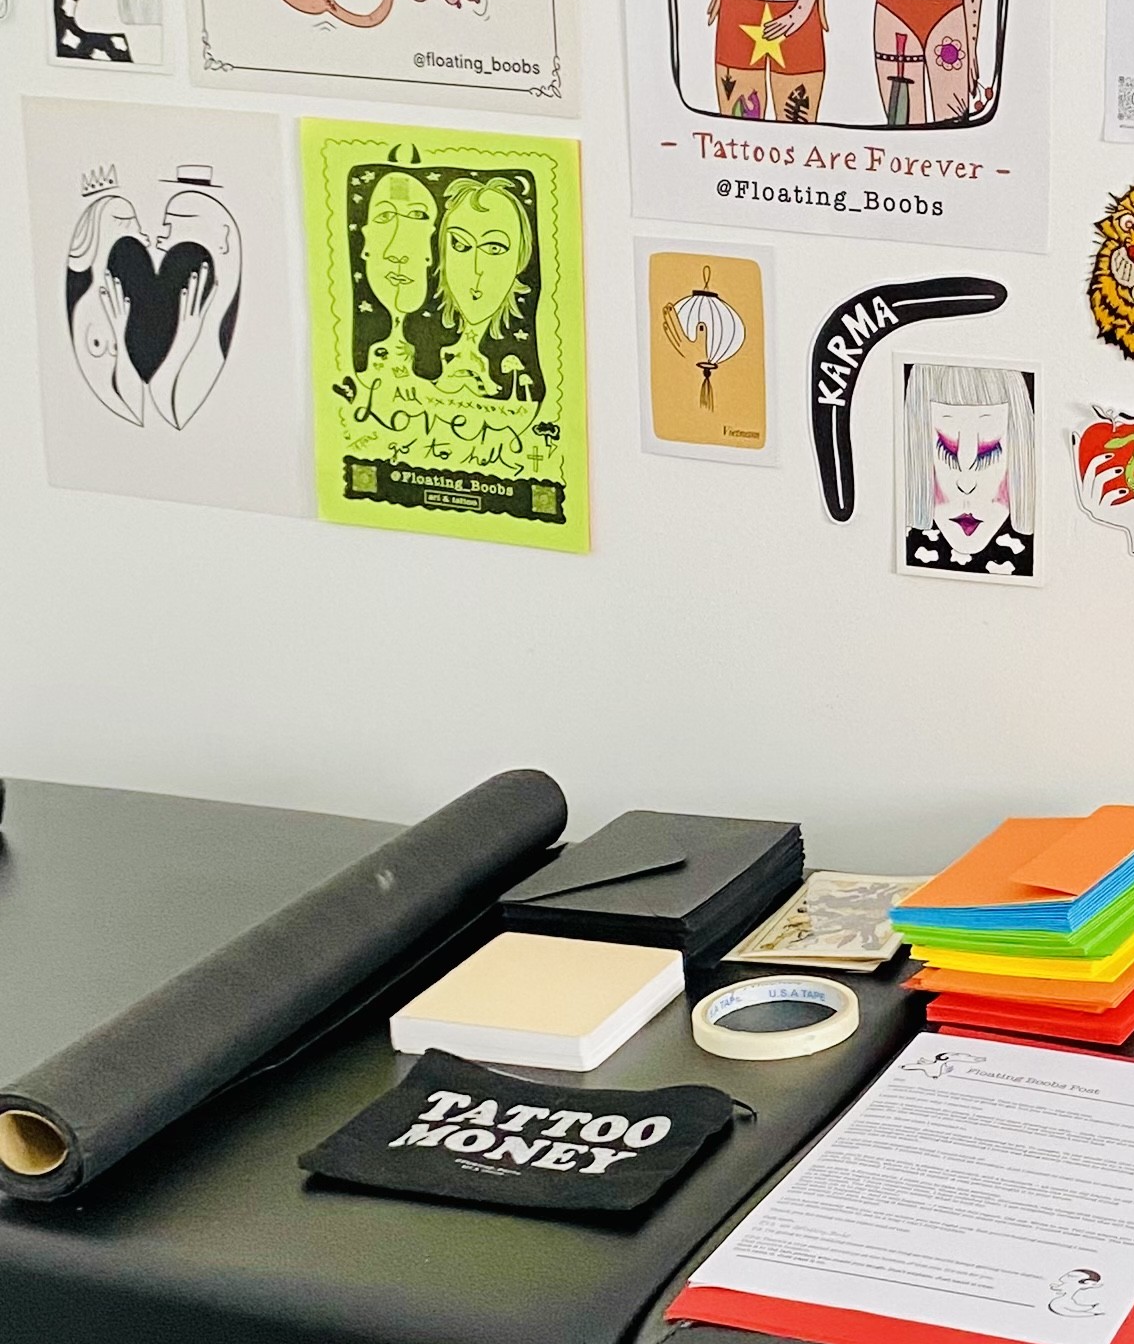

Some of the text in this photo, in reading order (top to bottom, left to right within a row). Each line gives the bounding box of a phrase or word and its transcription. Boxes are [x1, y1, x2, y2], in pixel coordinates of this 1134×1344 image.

[413, 51, 541, 76] @floating_boobs
[692, 132, 796, 167] Tattoos
[803, 145, 858, 171] Are
[863, 146, 985, 180] Forever
[716, 179, 944, 217] @Floating_Boobs
[818, 296, 899, 406] KARMA
[392, 386, 423, 405] All
[354, 378, 522, 453] Lovers
[388, 438, 418, 464] go
[424, 438, 454, 459] to
[460, 443, 508, 467] hell
[391, 470, 514, 496] @Floating_Boobs
[801, 989, 826, 1002] TAPE
[966, 1067, 1101, 1095] Floating Boobs Post
[418, 1090, 672, 1148] TATTOO
[388, 1123, 637, 1174] MONEY
